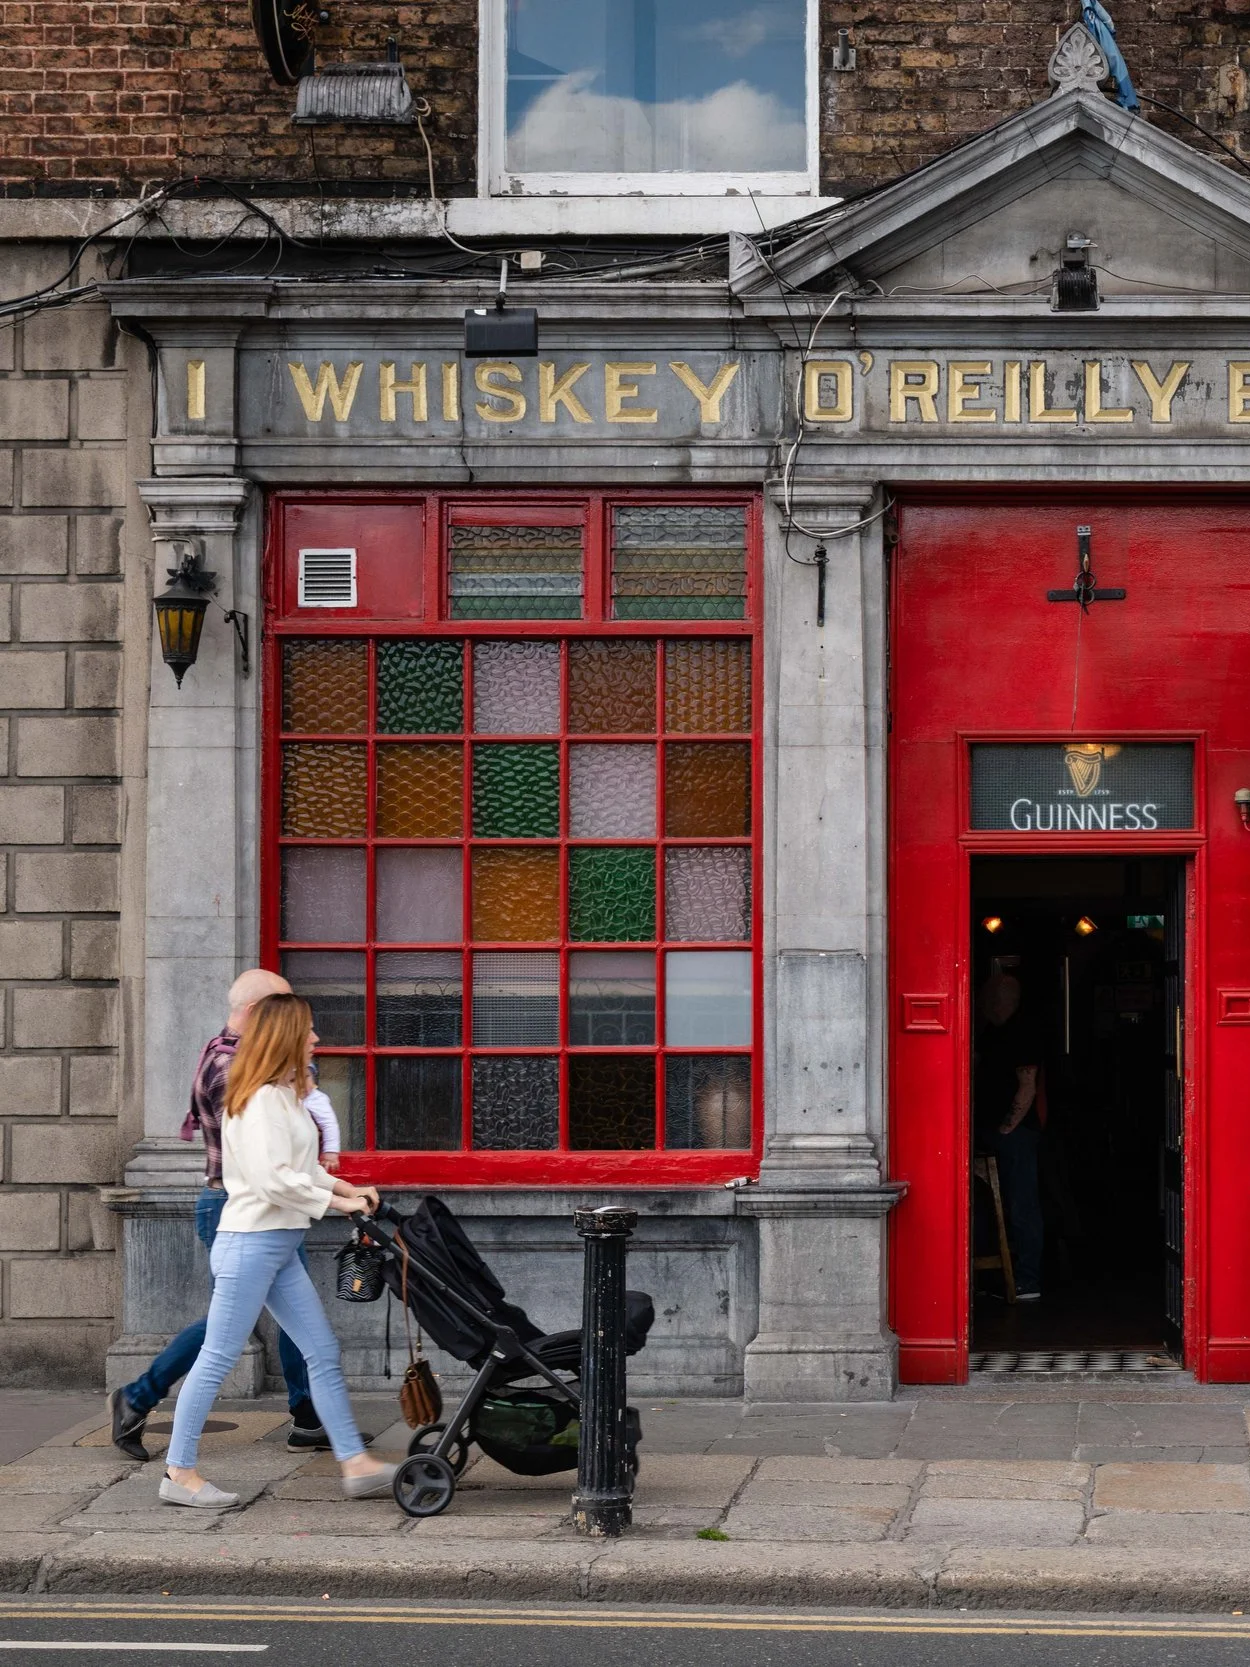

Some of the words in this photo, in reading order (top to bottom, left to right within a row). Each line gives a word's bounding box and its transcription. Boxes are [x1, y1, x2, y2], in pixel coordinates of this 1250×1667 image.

[287, 360, 740, 423] WHISKEY
[804, 350, 1194, 423] O'REILLY
[1010, 798, 1158, 831] GUINNESS
